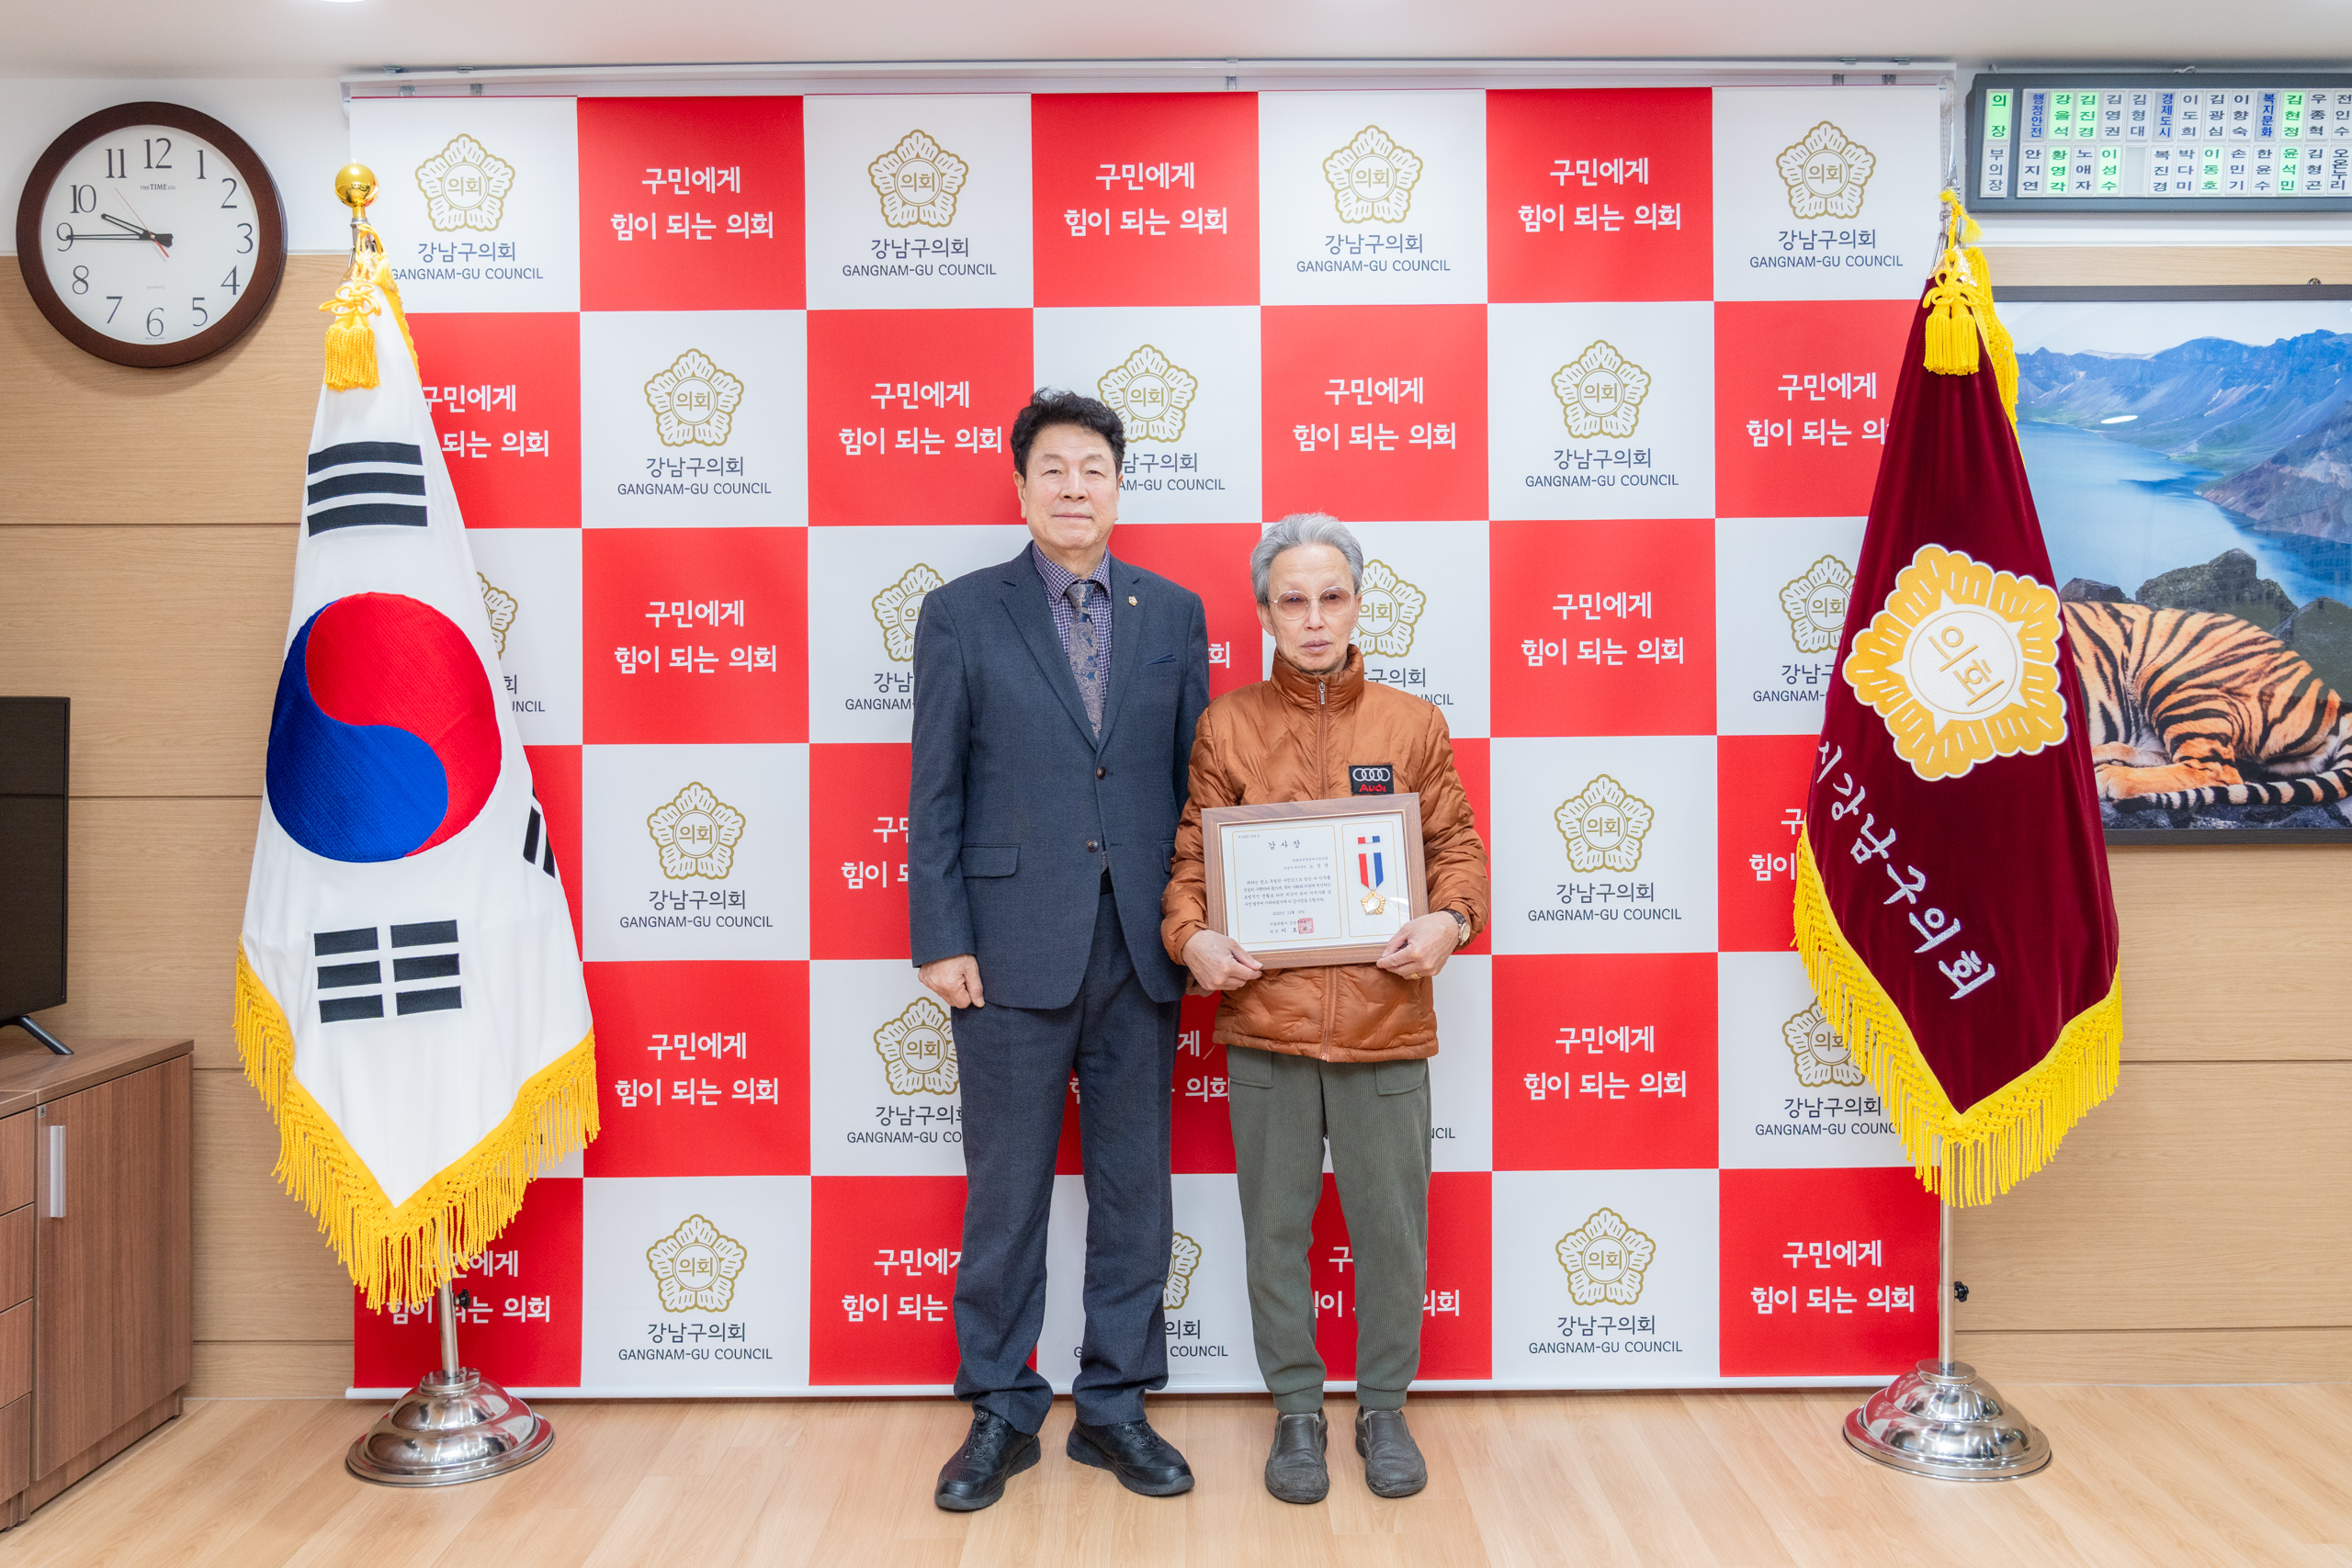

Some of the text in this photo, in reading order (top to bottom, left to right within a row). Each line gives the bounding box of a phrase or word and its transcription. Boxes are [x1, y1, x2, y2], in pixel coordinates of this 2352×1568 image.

[2030, 94, 2044, 138] 행정안전
[2078, 95, 2096, 137] 김진경
[2104, 95, 2122, 136] 김영권
[2131, 95, 2146, 137] 김형대
[2159, 94, 2173, 138] 경제도시
[2181, 95, 2199, 137] 이도희
[2208, 95, 2225, 136] 김광심
[2232, 95, 2249, 136] 이향숙
[2261, 94, 2275, 137] 복지문화
[2284, 95, 2302, 137] 김현정
[2309, 94, 2326, 135] 우종혁
[2335, 95, 2352, 136] 전인수
[105, 148, 128, 178] 11
[143, 138, 173, 169] 12
[197, 150, 207, 179] 1
[642, 166, 740, 194] 구민에게
[901, 172, 937, 192] 의회
[1096, 163, 1194, 190] 구민에게
[1355, 168, 1391, 188] 의회
[1550, 158, 1647, 186] 구민에게
[1809, 164, 1845, 185] 의회
[1989, 149, 2004, 191] 부의장
[2023, 149, 2041, 191] 안지연
[2075, 150, 2093, 190] 노애자
[2101, 149, 2118, 191] 이성수
[2154, 151, 2170, 192] 복진경
[2177, 150, 2195, 191] 박다미
[2201, 149, 2220, 189] 이동호
[2229, 149, 2246, 190] 손민기
[2255, 149, 2272, 190] 한윤수
[2281, 149, 2299, 190] 윤석민
[2331, 149, 2349, 190] 오온누리
[70, 185, 96, 214] 10
[220, 178, 237, 209] 2
[447, 175, 483, 196] 의회
[611, 212, 773, 241] 힘이 되는 의회
[1065, 208, 1227, 236] 힘이 되는 의회
[1519, 203, 1680, 232] 힘이 되는 의회
[56, 222, 74, 252] 9
[236, 222, 254, 254] 3
[871, 238, 967, 259] 강남구의회
[1326, 234, 1422, 254] 강남구의회
[1779, 230, 1875, 250] 강남구의회
[418, 242, 514, 263] 강남구의회
[1297, 260, 1450, 272] GANGNAM-GU COUNCIL
[1750, 255, 1903, 267] GANGNAM-GU COUNCIL
[72, 265, 89, 295] 8
[220, 265, 241, 295] 4
[485, 268, 543, 279] COUNCIL
[842, 264, 996, 276] GANGNAM-GU COUNCIL
[106, 296, 123, 323] 7
[146, 307, 164, 336] 6
[192, 297, 208, 326] 5
[423, 385, 516, 412] 구민에게
[675, 390, 711, 411] 의회
[871, 381, 969, 409] 구민에게
[1129, 387, 1165, 407] 의회
[1325, 378, 1423, 405] 구민에게
[1583, 382, 1619, 403] 의회
[1778, 373, 1876, 400] 구민에게
[442, 431, 548, 457] 되는 의회
[839, 426, 1001, 455] 힘이 되는 의회
[1294, 423, 1455, 451] 힘이 되는 의회
[1747, 419, 1851, 446] 힘이 되는
[647, 457, 742, 478] 강남구의회
[1555, 448, 1650, 469] 강남구의회
[618, 483, 771, 494] GANGNAM-GU COUNCIL
[1168, 479, 1225, 490] COUNCIL
[1526, 475, 1679, 487] GANGNAM-GU COUNCIL
[646, 600, 743, 627] 구민에게
[1360, 602, 1393, 622] 의회
[1553, 592, 1651, 620] 구민에게
[1811, 597, 1846, 617] 의회
[615, 646, 775, 673] 힘이 되는 의회
[1521, 637, 1683, 666] 힘이 되는 의회
[1928, 626, 2004, 706] 의회
[1359, 784, 1386, 792] Audi
[677, 823, 713, 844] 의회
[1585, 816, 1621, 837] 의회
[842, 862, 887, 888] 힘이
[1749, 853, 1794, 881] 힘이
[650, 890, 745, 910] 강남구의회
[1557, 883, 1653, 904] 강남구의회
[620, 916, 773, 928] GANGNAM-GU COUNCIL
[1529, 908, 1681, 920] GANGNAM-GU COUNCIL
[648, 1032, 746, 1060] 구민에게
[905, 1038, 941, 1059] 의회
[1555, 1026, 1654, 1054] 구민에게
[616, 1077, 777, 1107] 힘이 되는 의회
[1524, 1071, 1686, 1100] 힘이 되는 의회
[1784, 1096, 1881, 1118] 강남구의회
[847, 1132, 937, 1143] GANGNAM-GU
[1756, 1123, 1846, 1135] GANGNAM-GU
[679, 1257, 715, 1277] 의회
[1588, 1250, 1623, 1270] 의회
[1783, 1240, 1881, 1268] 구민에게
[503, 1295, 549, 1322] 의회
[842, 1294, 947, 1322] 힘이 되는
[1751, 1285, 1914, 1314] 힘이 되는 의회
[648, 1323, 744, 1343] 강남구의회
[1558, 1315, 1654, 1337] 강남구의회
[619, 1348, 773, 1359] GANGNAM-GU COUNCIL
[1170, 1346, 1227, 1357] COUNCIL
[1529, 1341, 1682, 1353] GANGNAM-GU COUNCIL
